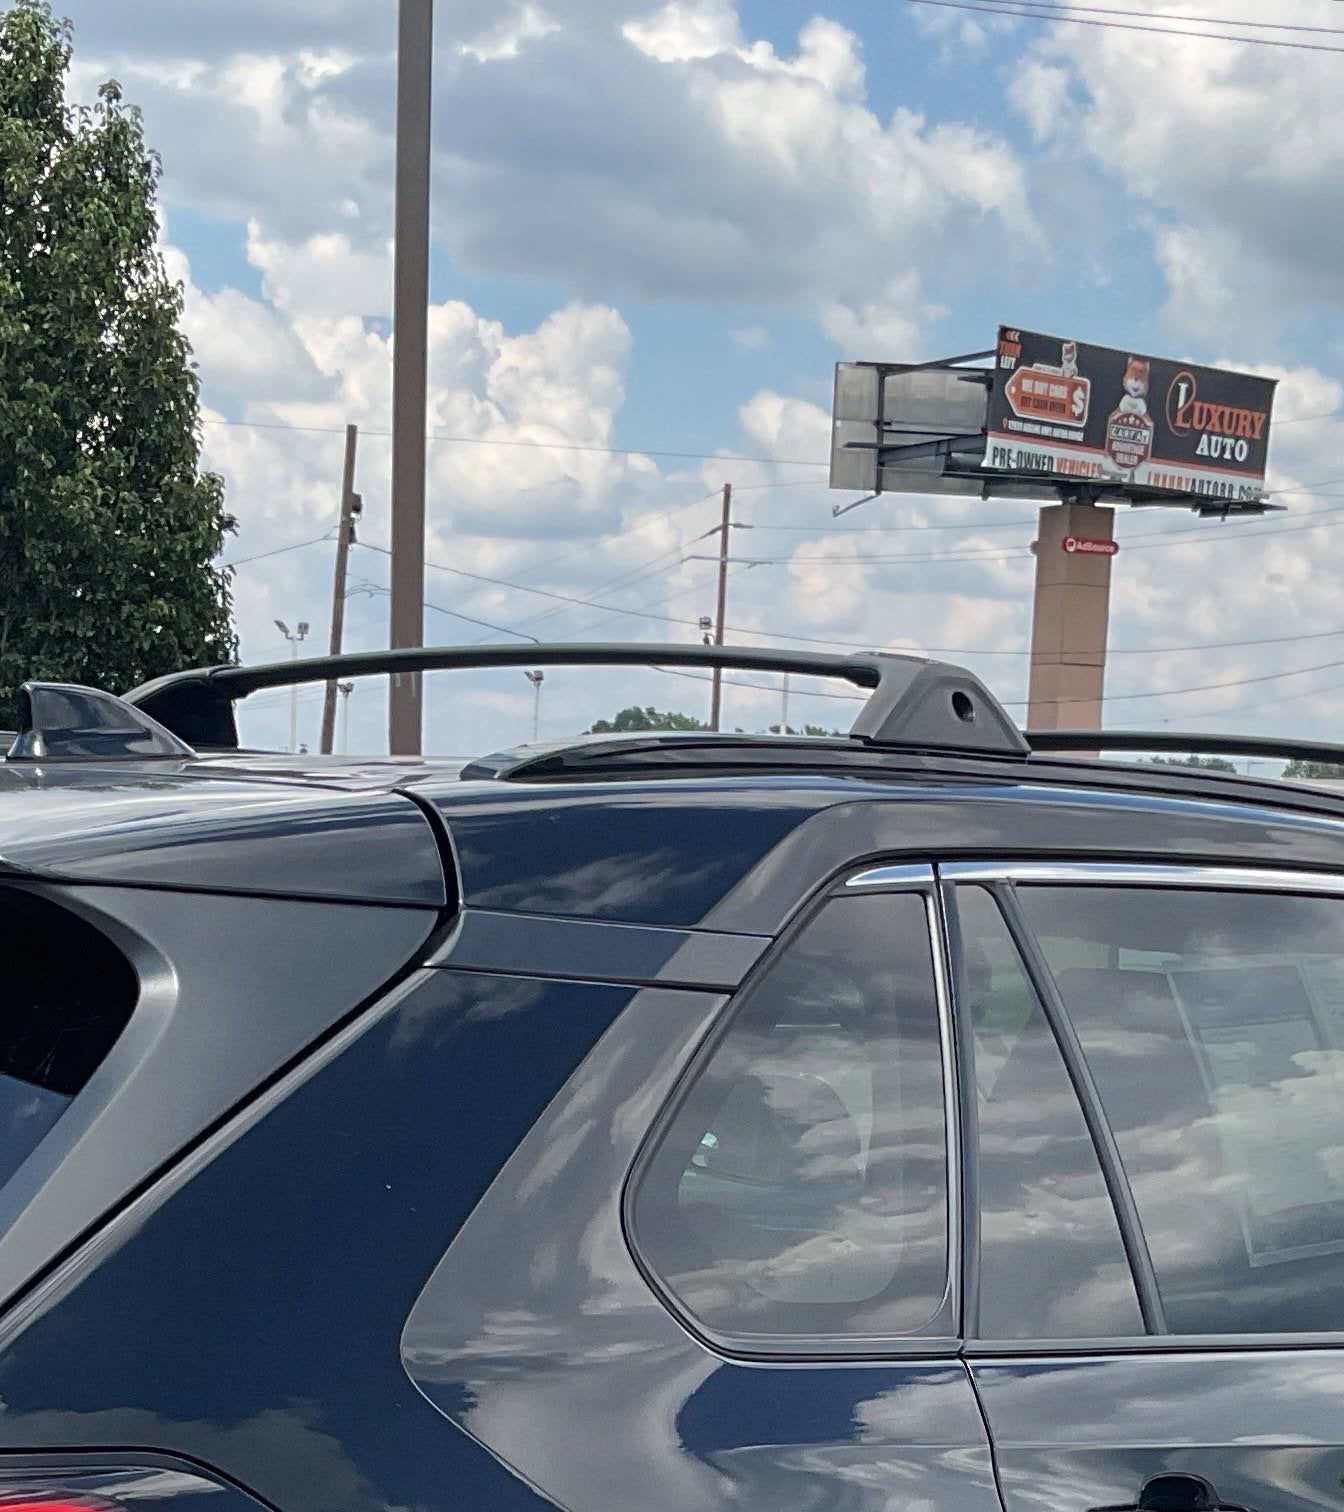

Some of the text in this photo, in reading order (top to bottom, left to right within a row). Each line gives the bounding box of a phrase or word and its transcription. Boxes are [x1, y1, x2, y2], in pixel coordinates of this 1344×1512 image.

[1171, 380, 1266, 440] LUXURY
[992, 446, 1105, 479] PRE-OWNED VEHICLES
[1195, 433, 1248, 462] AUTO
